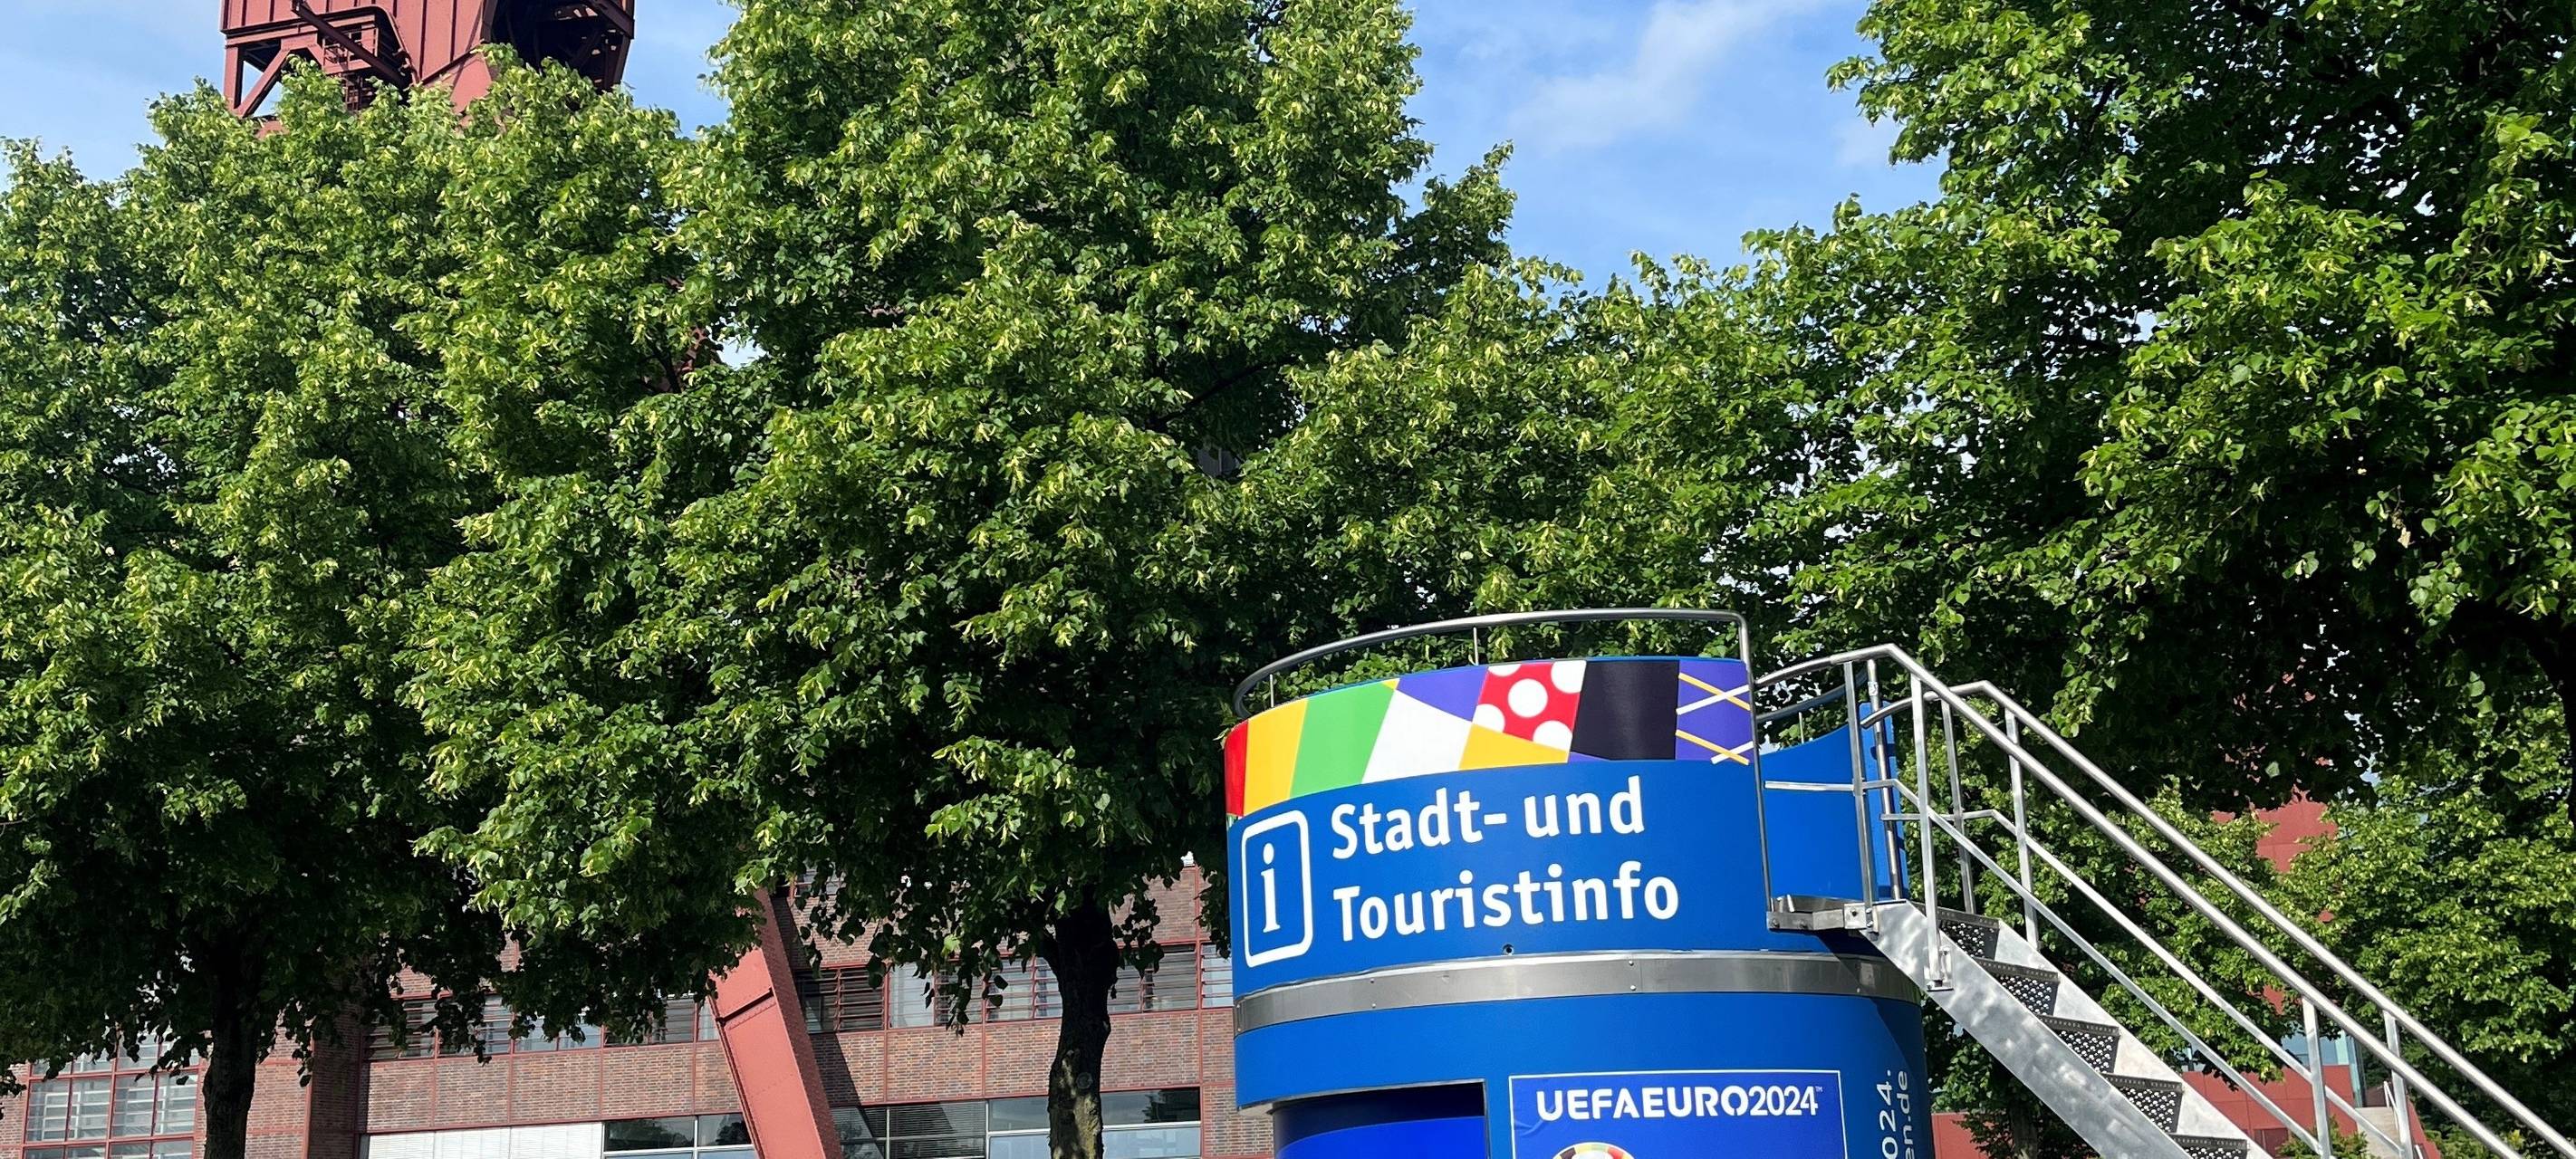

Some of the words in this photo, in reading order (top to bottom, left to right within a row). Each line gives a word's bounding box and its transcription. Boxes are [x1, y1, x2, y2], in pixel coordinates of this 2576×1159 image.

[1331, 786, 1508, 860] Stadt-
[1523, 775, 1646, 839] und
[1332, 860, 1679, 943] Touristinfo
